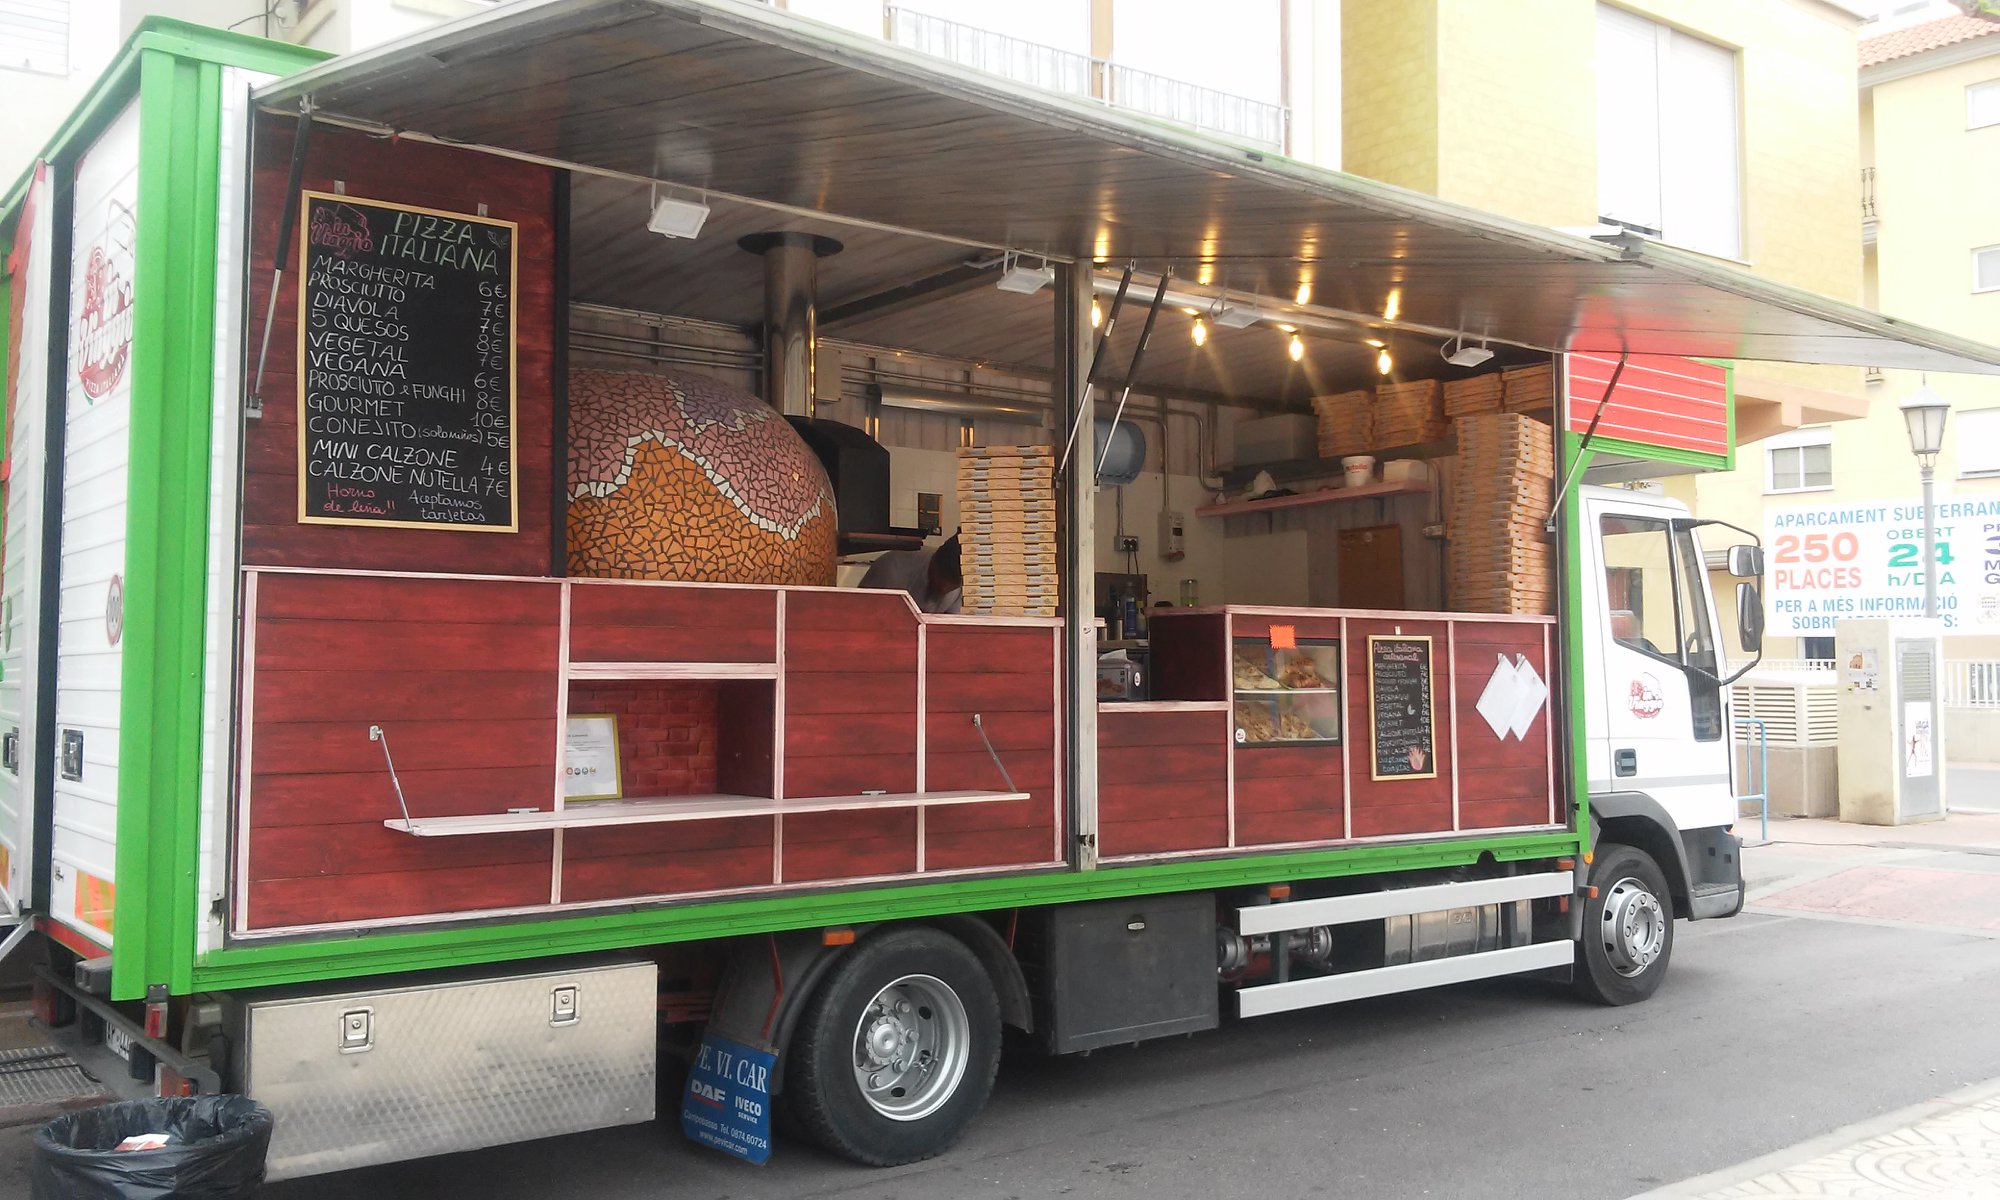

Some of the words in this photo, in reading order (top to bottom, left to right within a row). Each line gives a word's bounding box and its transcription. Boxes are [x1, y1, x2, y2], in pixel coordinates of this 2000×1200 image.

[393, 212, 476, 245] PIZZA
[380, 235, 499, 276] ITALIANA
[312, 254, 436, 290] MARGHERITA
[478, 281, 508, 299] 6€
[308, 270, 406, 303] PROSCIUTTO
[479, 300, 505, 318] 7€
[313, 290, 400, 321] DIAVOLA
[479, 317, 505, 336] 7€
[311, 308, 328, 328] 5
[333, 313, 410, 342] QUESOS
[476, 334, 504, 353] 8€
[308, 331, 409, 363] VEGETAL
[478, 352, 504, 370] 7€
[308, 350, 407, 380] VEGANA
[474, 372, 502, 391] 6€
[307, 392, 405, 417] GOURMET
[470, 412, 509, 428] 10€
[412, 383, 466, 403] FUNGHI
[476, 391, 502, 412] 8€
[309, 416, 416, 439] CONEJITO
[487, 431, 510, 449] 5€
[312, 439, 359, 459] MINI
[366, 443, 458, 469] CALZONE
[308, 459, 404, 484] CALZONE
[409, 469, 478, 495] NUTELLA
[483, 477, 508, 498] 7€
[327, 482, 376, 498] Horno
[323, 501, 342, 512] de
[408, 490, 483, 510] Aceptamos
[420, 508, 486, 522] tarjetas
[1774, 508, 1888, 528] APARCAMENT
[1774, 531, 1859, 564] 250
[1774, 567, 1863, 590] PLACES
[1775, 599, 1802, 613] PER
[1808, 598, 1818, 612] A
[690, 1079, 726, 1102] DAF
[736, 1059, 767, 1093] CAR
[735, 1095, 762, 1117] IVECO
